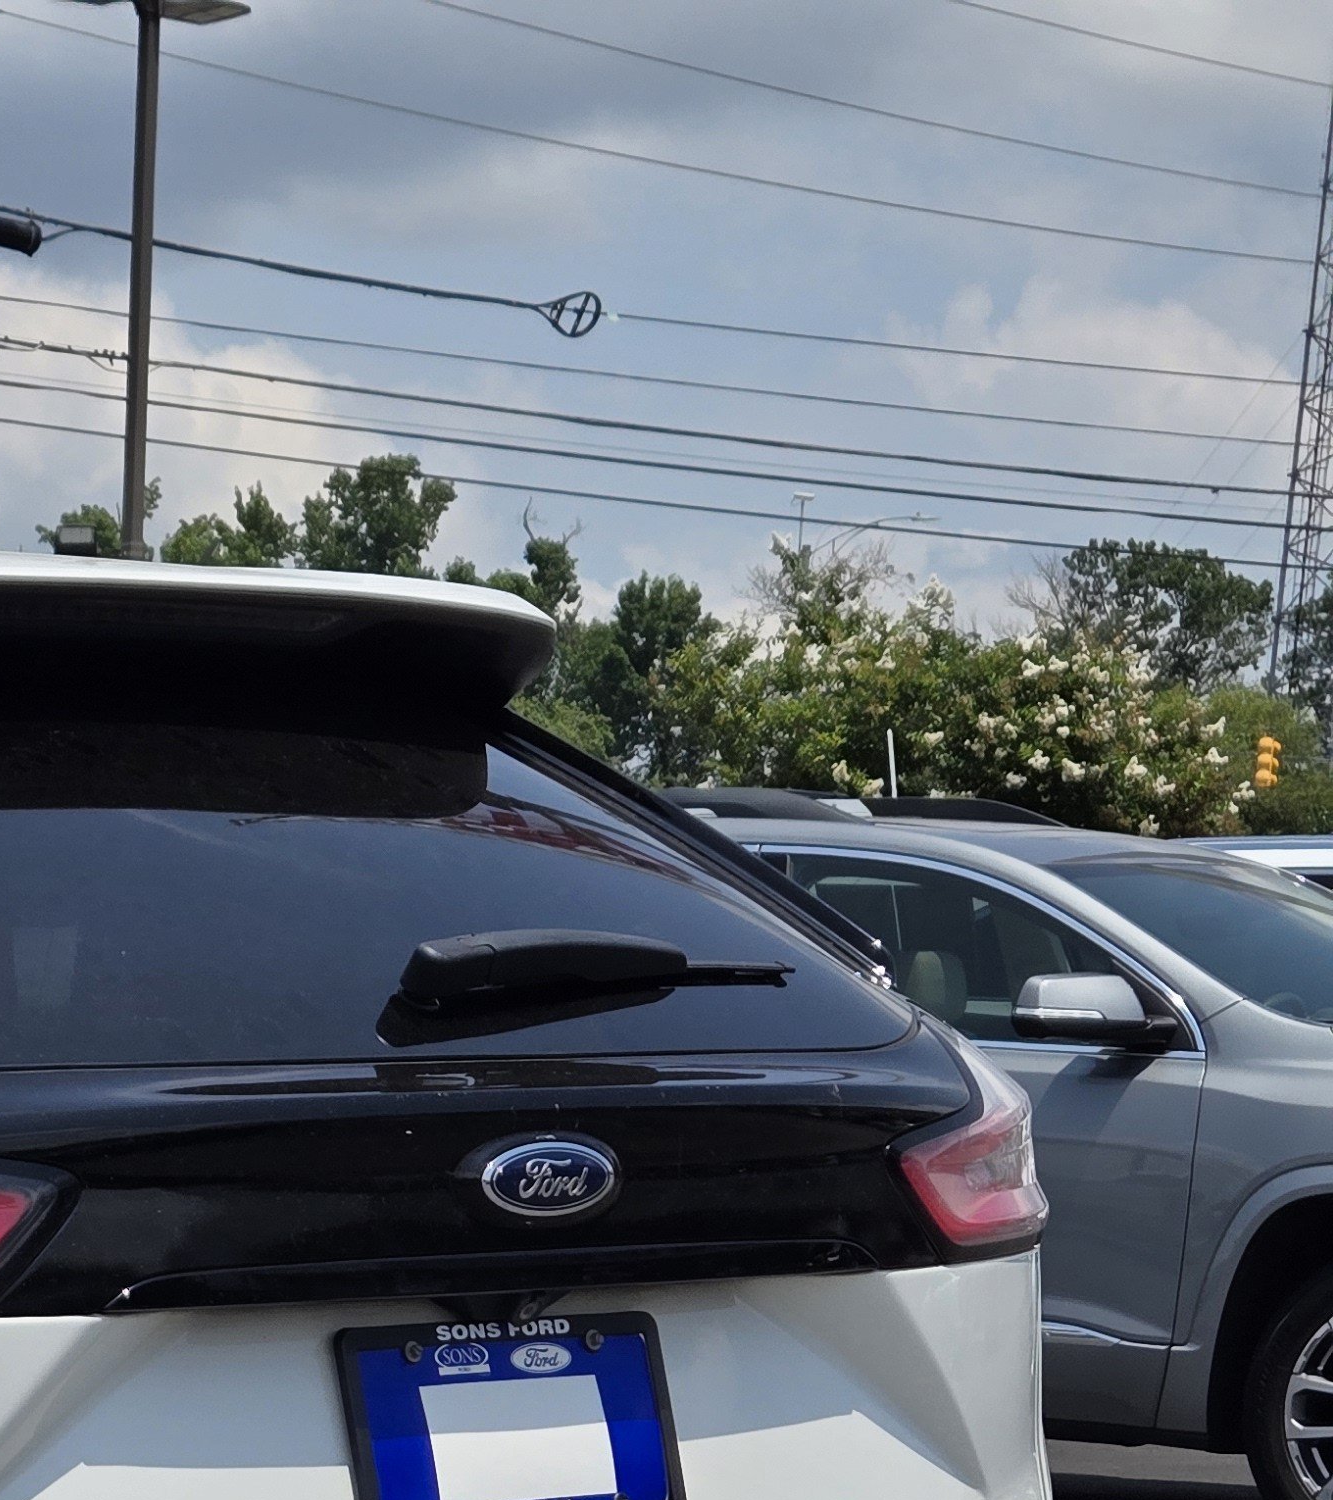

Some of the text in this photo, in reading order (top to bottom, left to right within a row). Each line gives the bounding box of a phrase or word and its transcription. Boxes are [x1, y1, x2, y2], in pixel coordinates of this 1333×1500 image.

[518, 1158, 589, 1199] Ford
[435, 1318, 571, 1341] SONS FORD
[442, 1347, 560, 1368] SONS Ford
